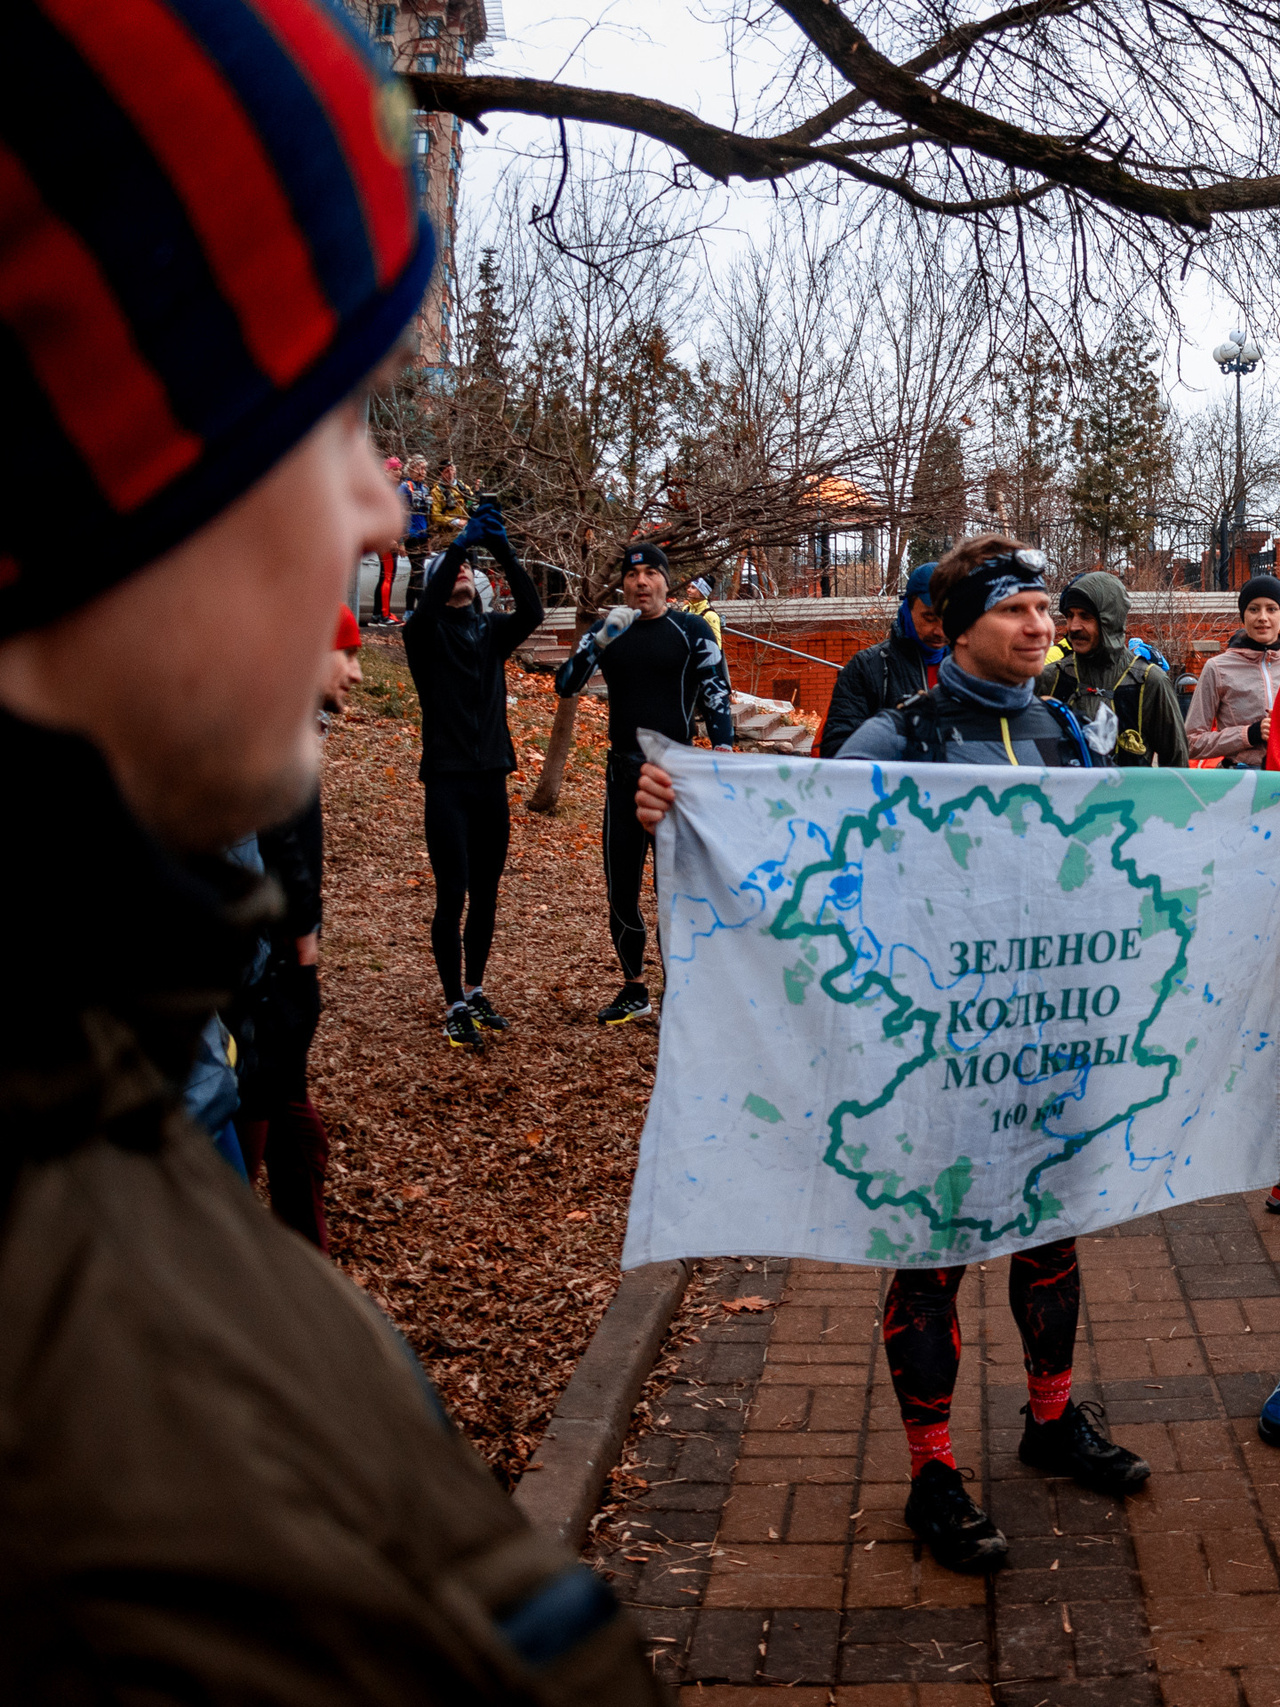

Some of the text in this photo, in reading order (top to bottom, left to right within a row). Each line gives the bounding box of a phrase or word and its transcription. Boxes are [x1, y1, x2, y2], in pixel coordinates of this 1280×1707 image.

[948, 927, 1142, 976] ЗЕЛЕНОЕ
[948, 984, 1121, 1034] КОЛЬЦО
[941, 1034, 1131, 1090] МОСКВЫ
[991, 1103, 1028, 1133] 160
